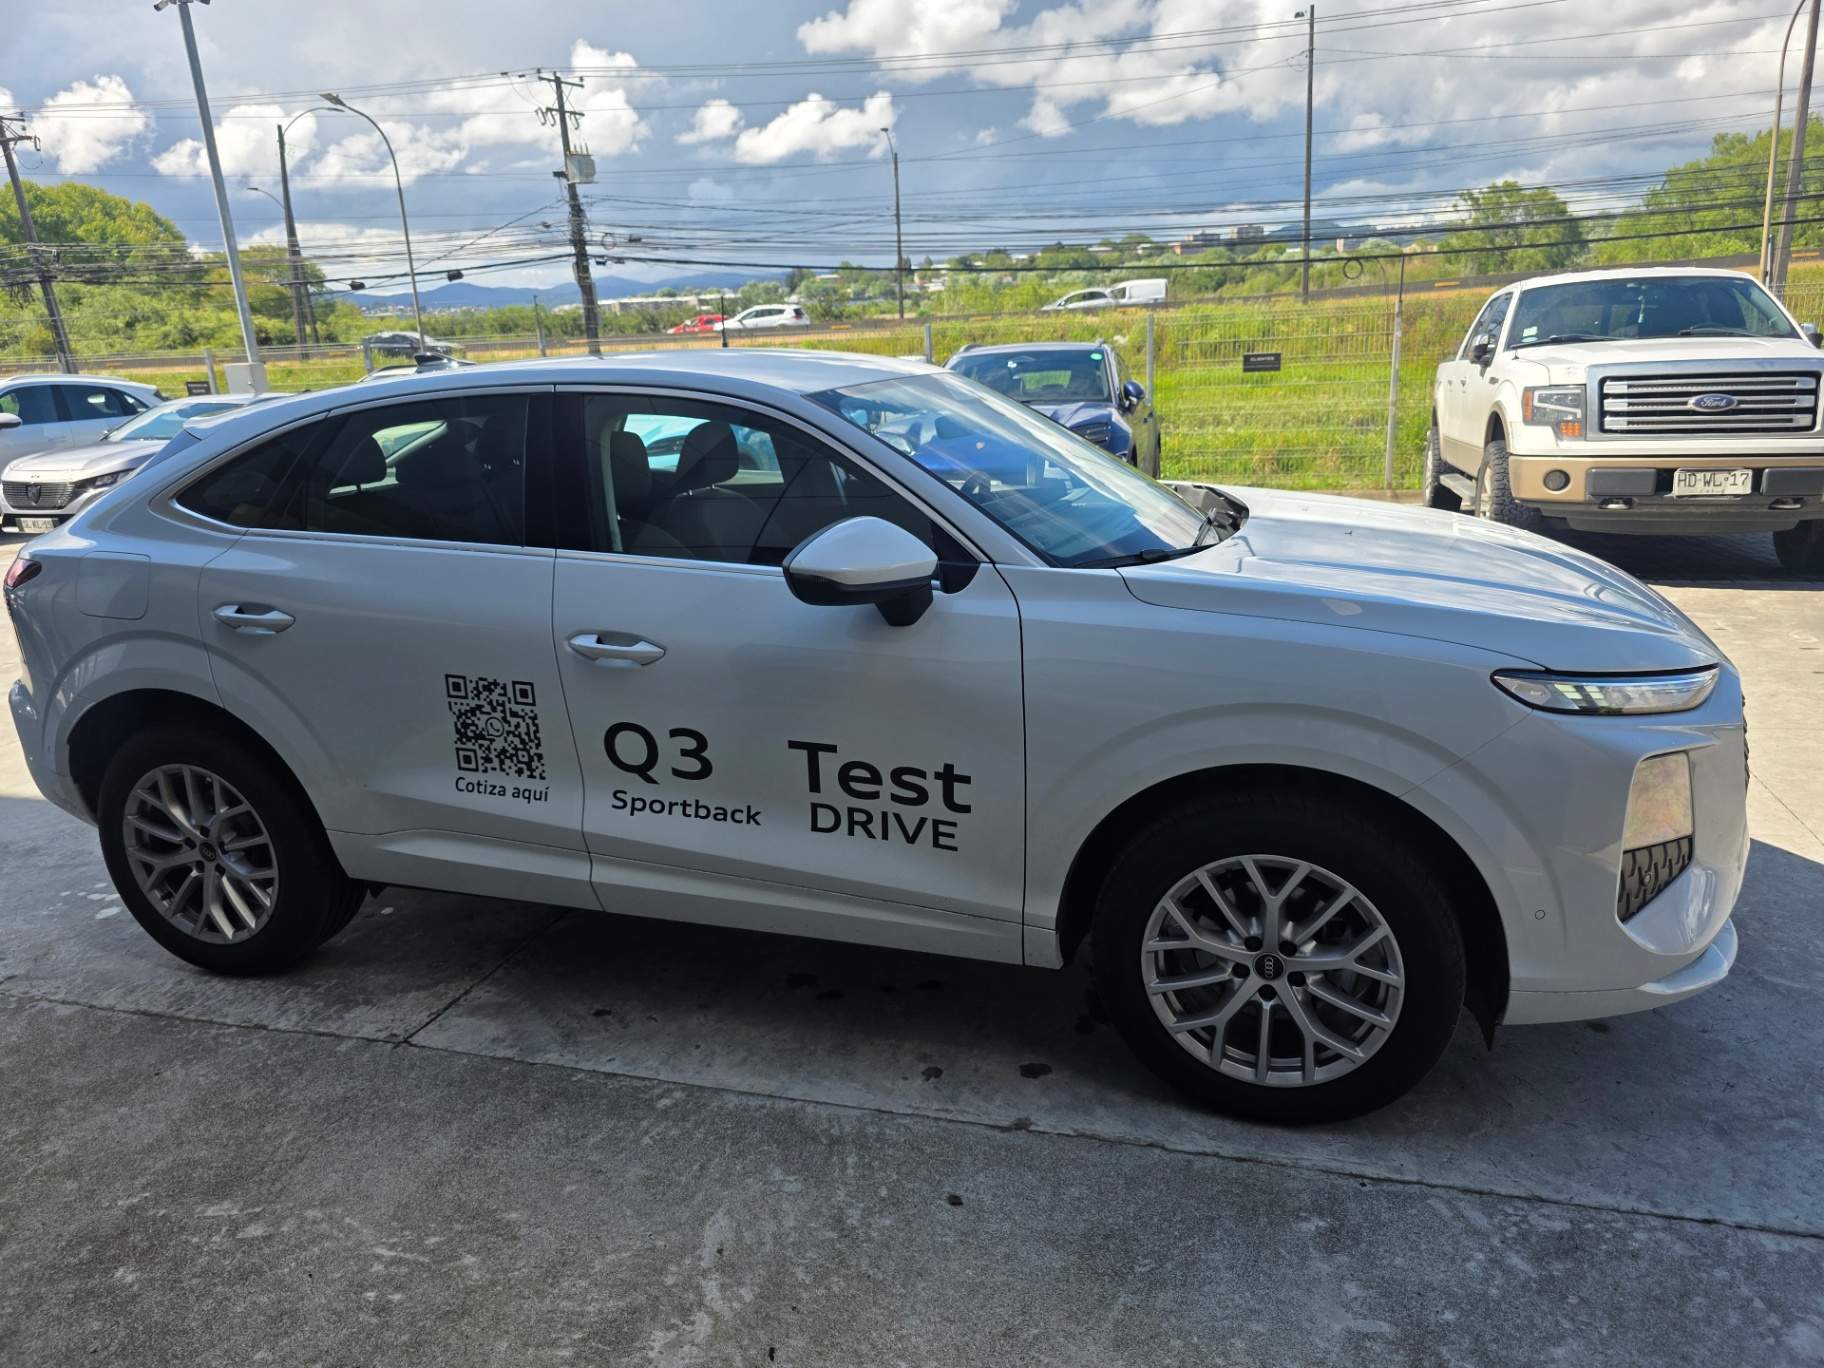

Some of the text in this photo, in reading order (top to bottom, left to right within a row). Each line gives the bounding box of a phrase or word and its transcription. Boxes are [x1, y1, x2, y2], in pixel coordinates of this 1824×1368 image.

[1700, 396, 1728, 408] Ford
[603, 721, 714, 785] Q3
[455, 777, 550, 804] Cotiza aquí
[787, 739, 972, 814] Test
[611, 789, 762, 826] Sportback
[809, 801, 959, 852] DRIVE
